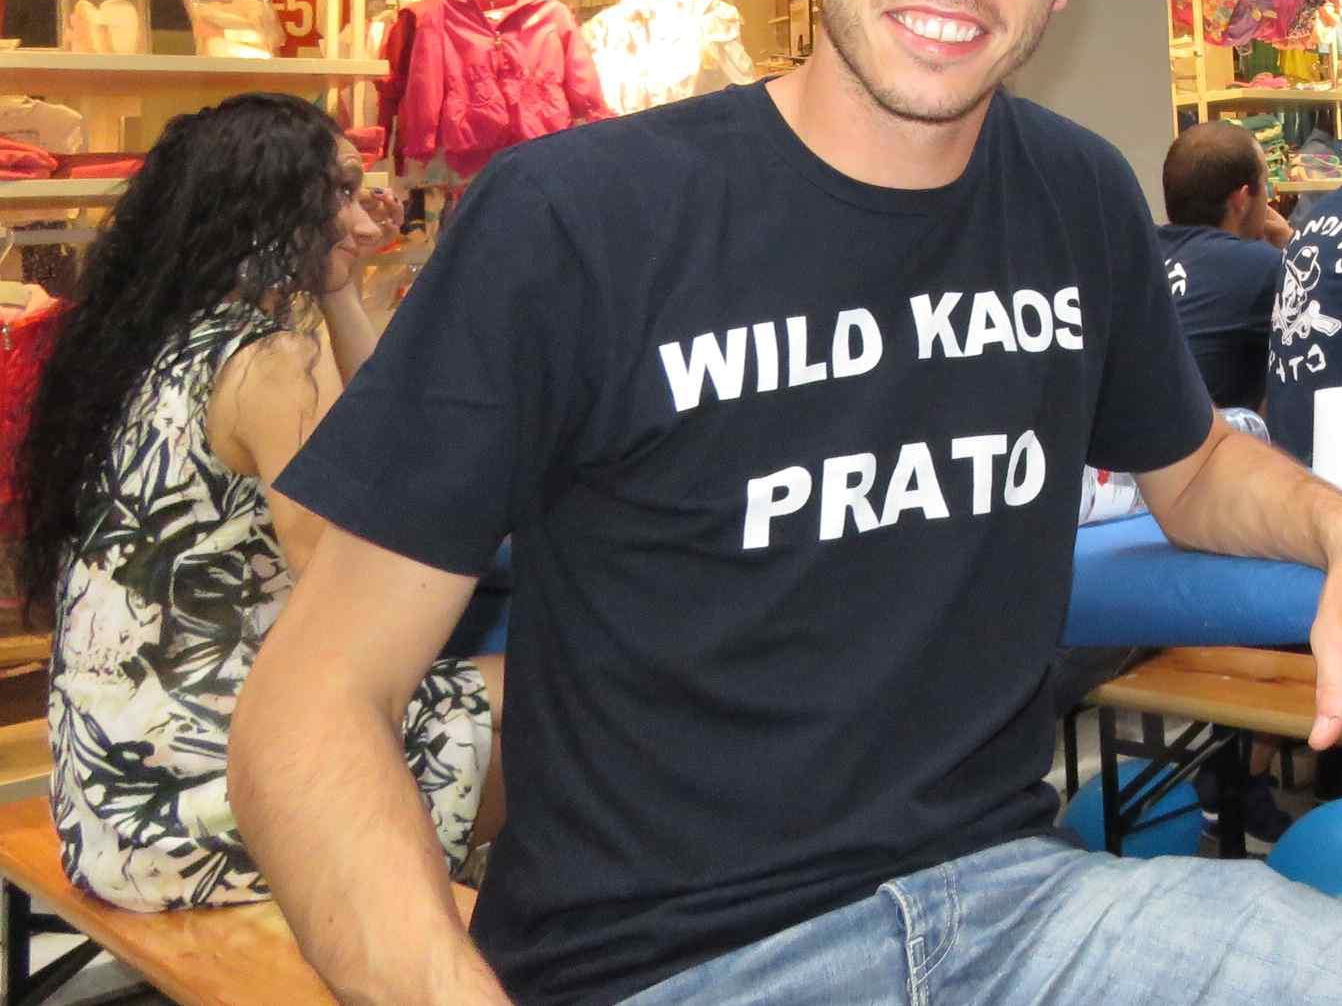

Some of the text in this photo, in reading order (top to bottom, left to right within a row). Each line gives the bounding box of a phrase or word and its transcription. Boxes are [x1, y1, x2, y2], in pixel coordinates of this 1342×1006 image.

[658, 286, 1084, 413] WILD KAOS
[742, 429, 1047, 551] PRATO
